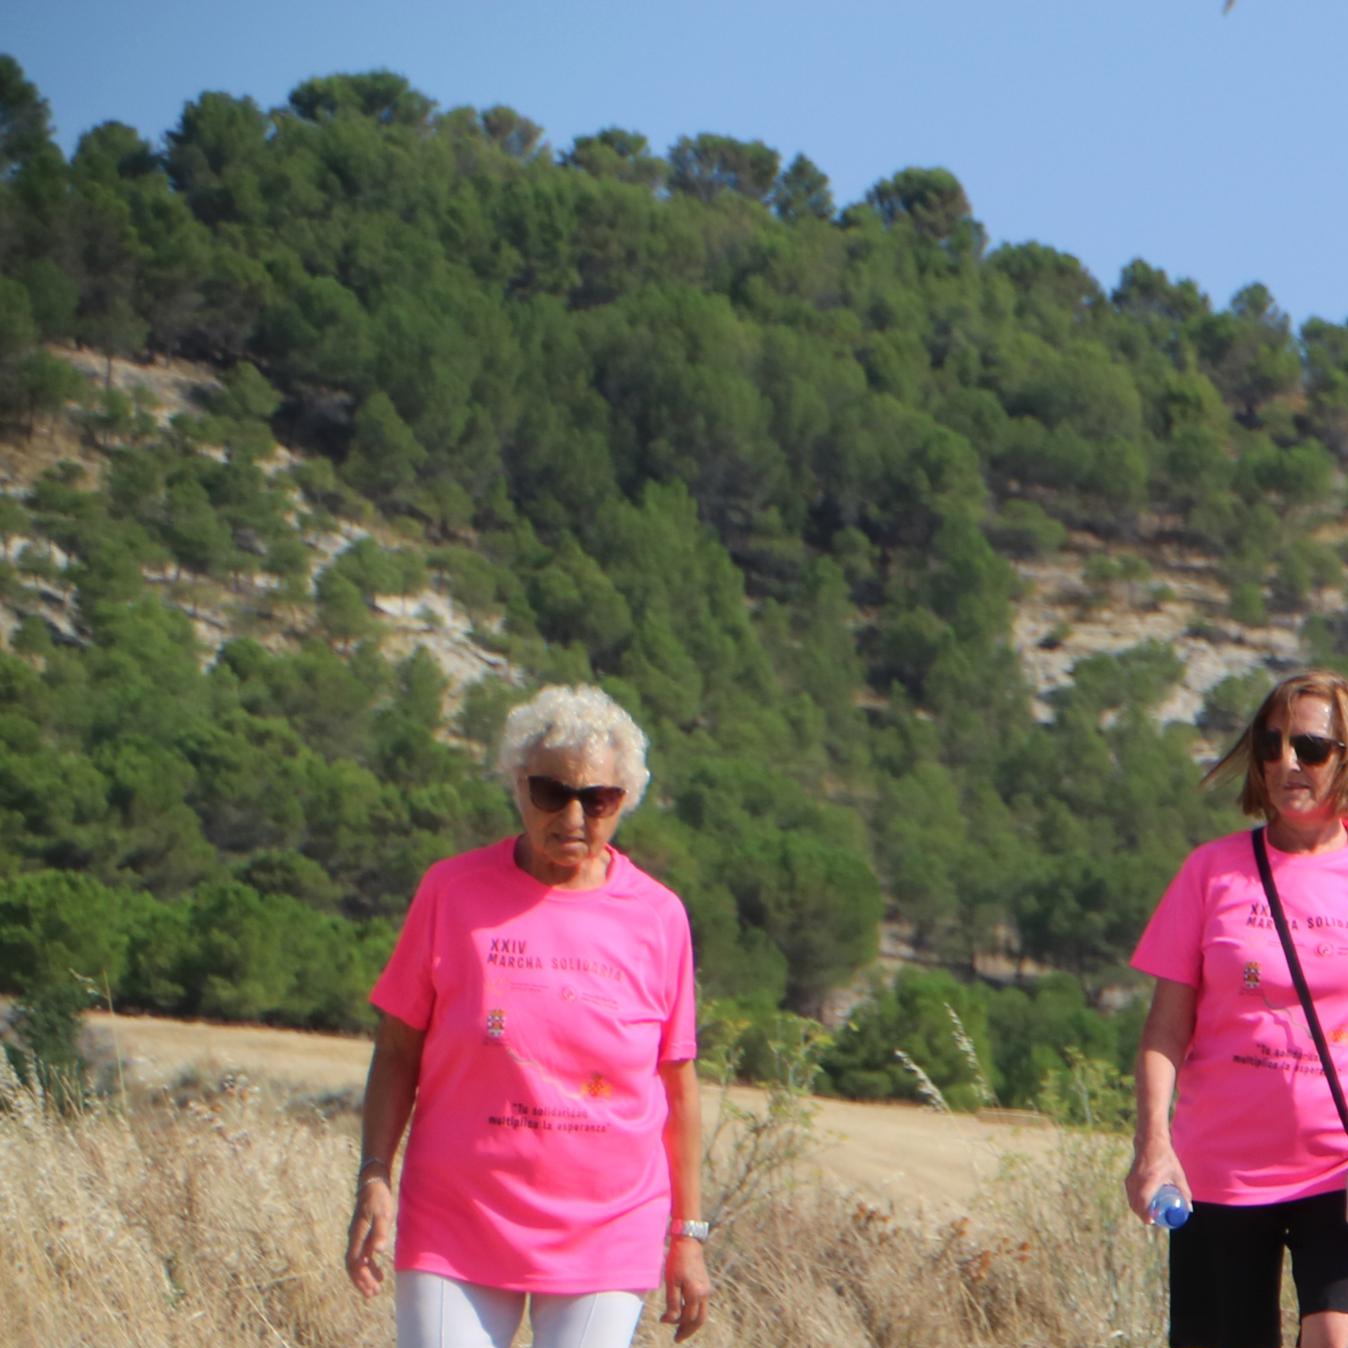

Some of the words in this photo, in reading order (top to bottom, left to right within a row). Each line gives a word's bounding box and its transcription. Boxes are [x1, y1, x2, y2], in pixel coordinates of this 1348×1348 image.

[490, 937, 527, 955] XXIV
[486, 952, 543, 970] MARCHA
[551, 957, 623, 982] SOLIDARIA
